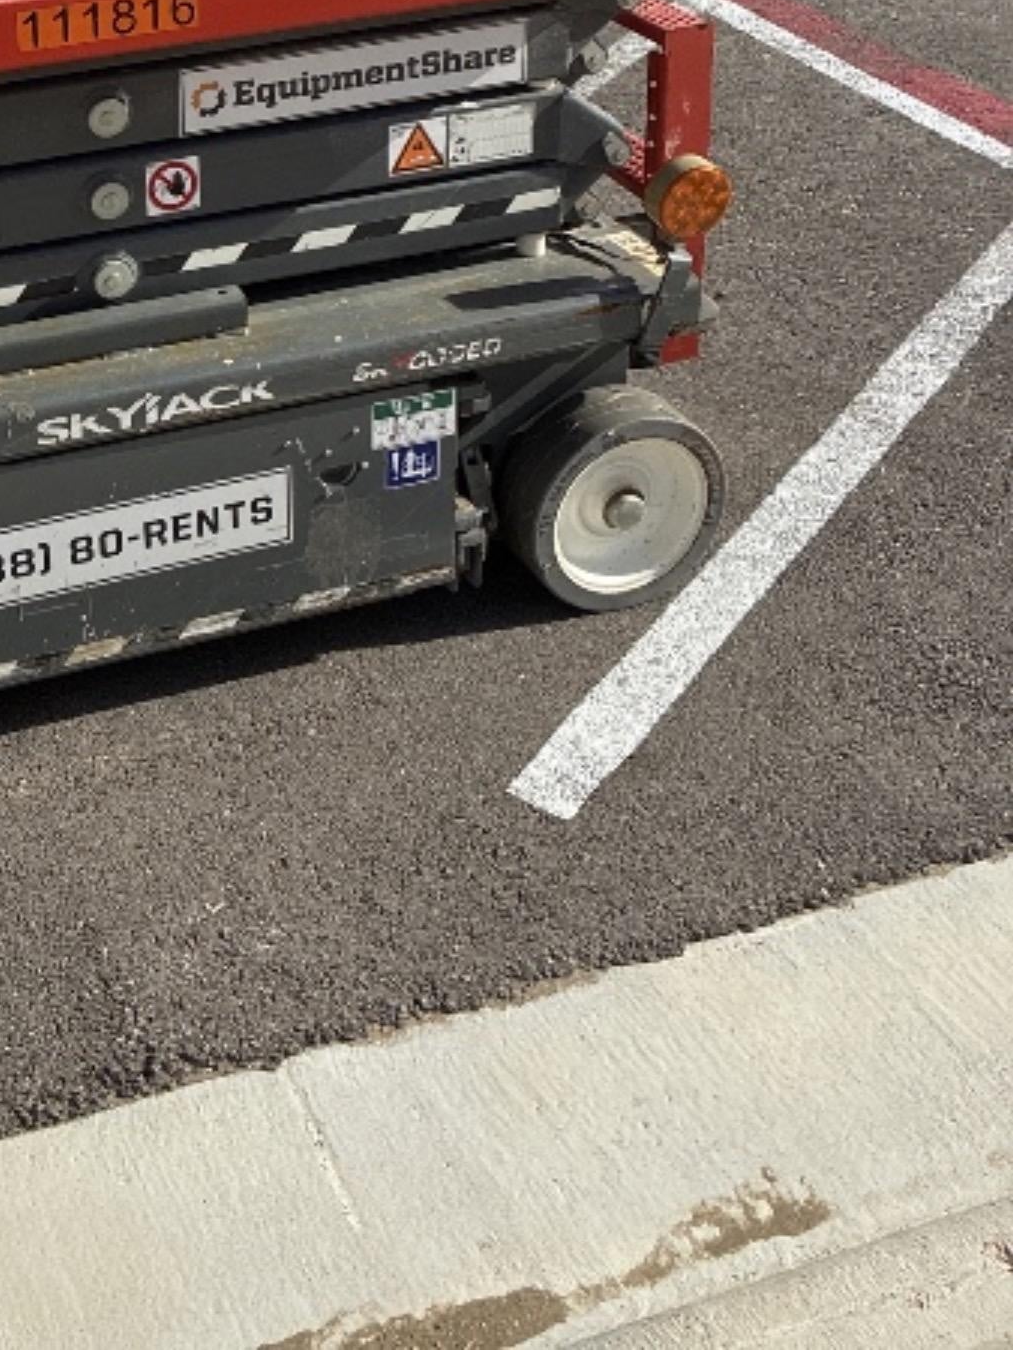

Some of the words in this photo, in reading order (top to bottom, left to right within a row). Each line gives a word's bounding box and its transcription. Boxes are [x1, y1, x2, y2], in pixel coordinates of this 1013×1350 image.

[232, 41, 517, 107] EquipmentShare
[36, 379, 275, 446] SKYJACK
[69, 496, 275, 565] 80-RENTS
